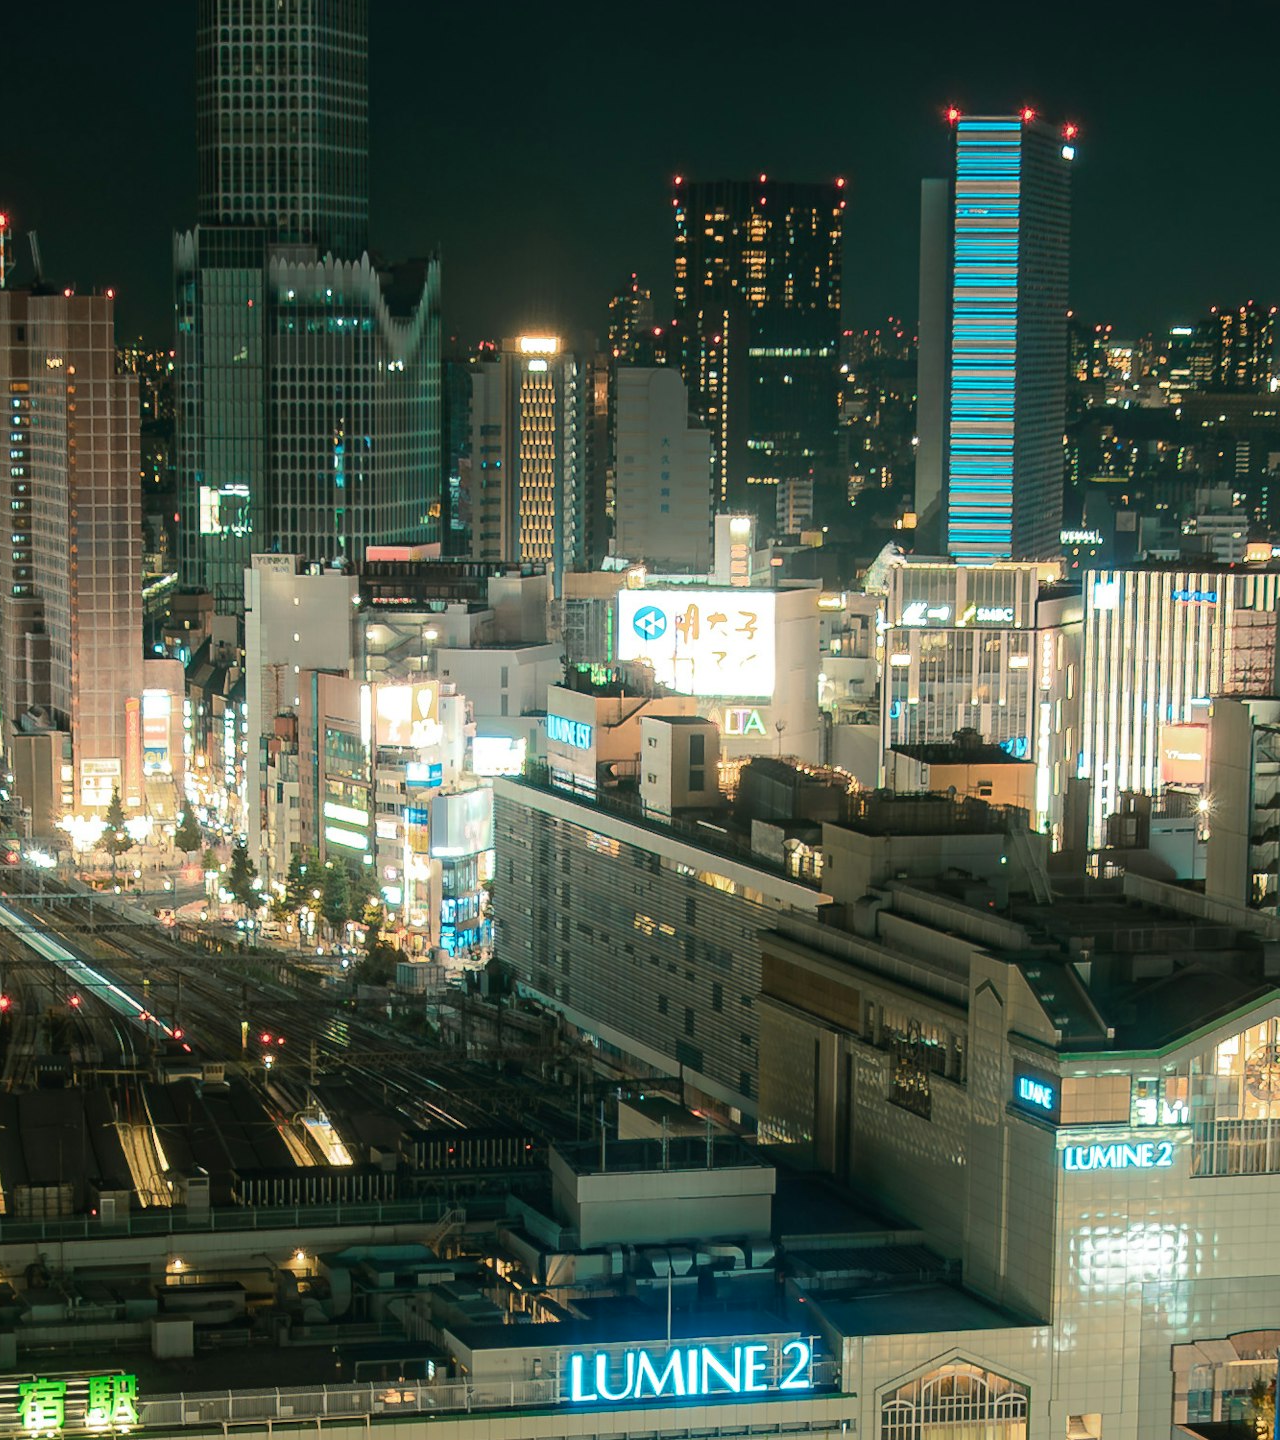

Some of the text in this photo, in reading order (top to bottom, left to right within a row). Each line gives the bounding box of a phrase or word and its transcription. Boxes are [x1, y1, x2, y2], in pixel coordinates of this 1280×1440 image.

[976, 607, 1014, 621] SMBC
[576, 722, 592, 750] EST
[708, 707, 767, 736] ALTA
[1064, 1142, 1174, 1171] LUMINE 2
[570, 1340, 814, 1403] LUMINE 2
